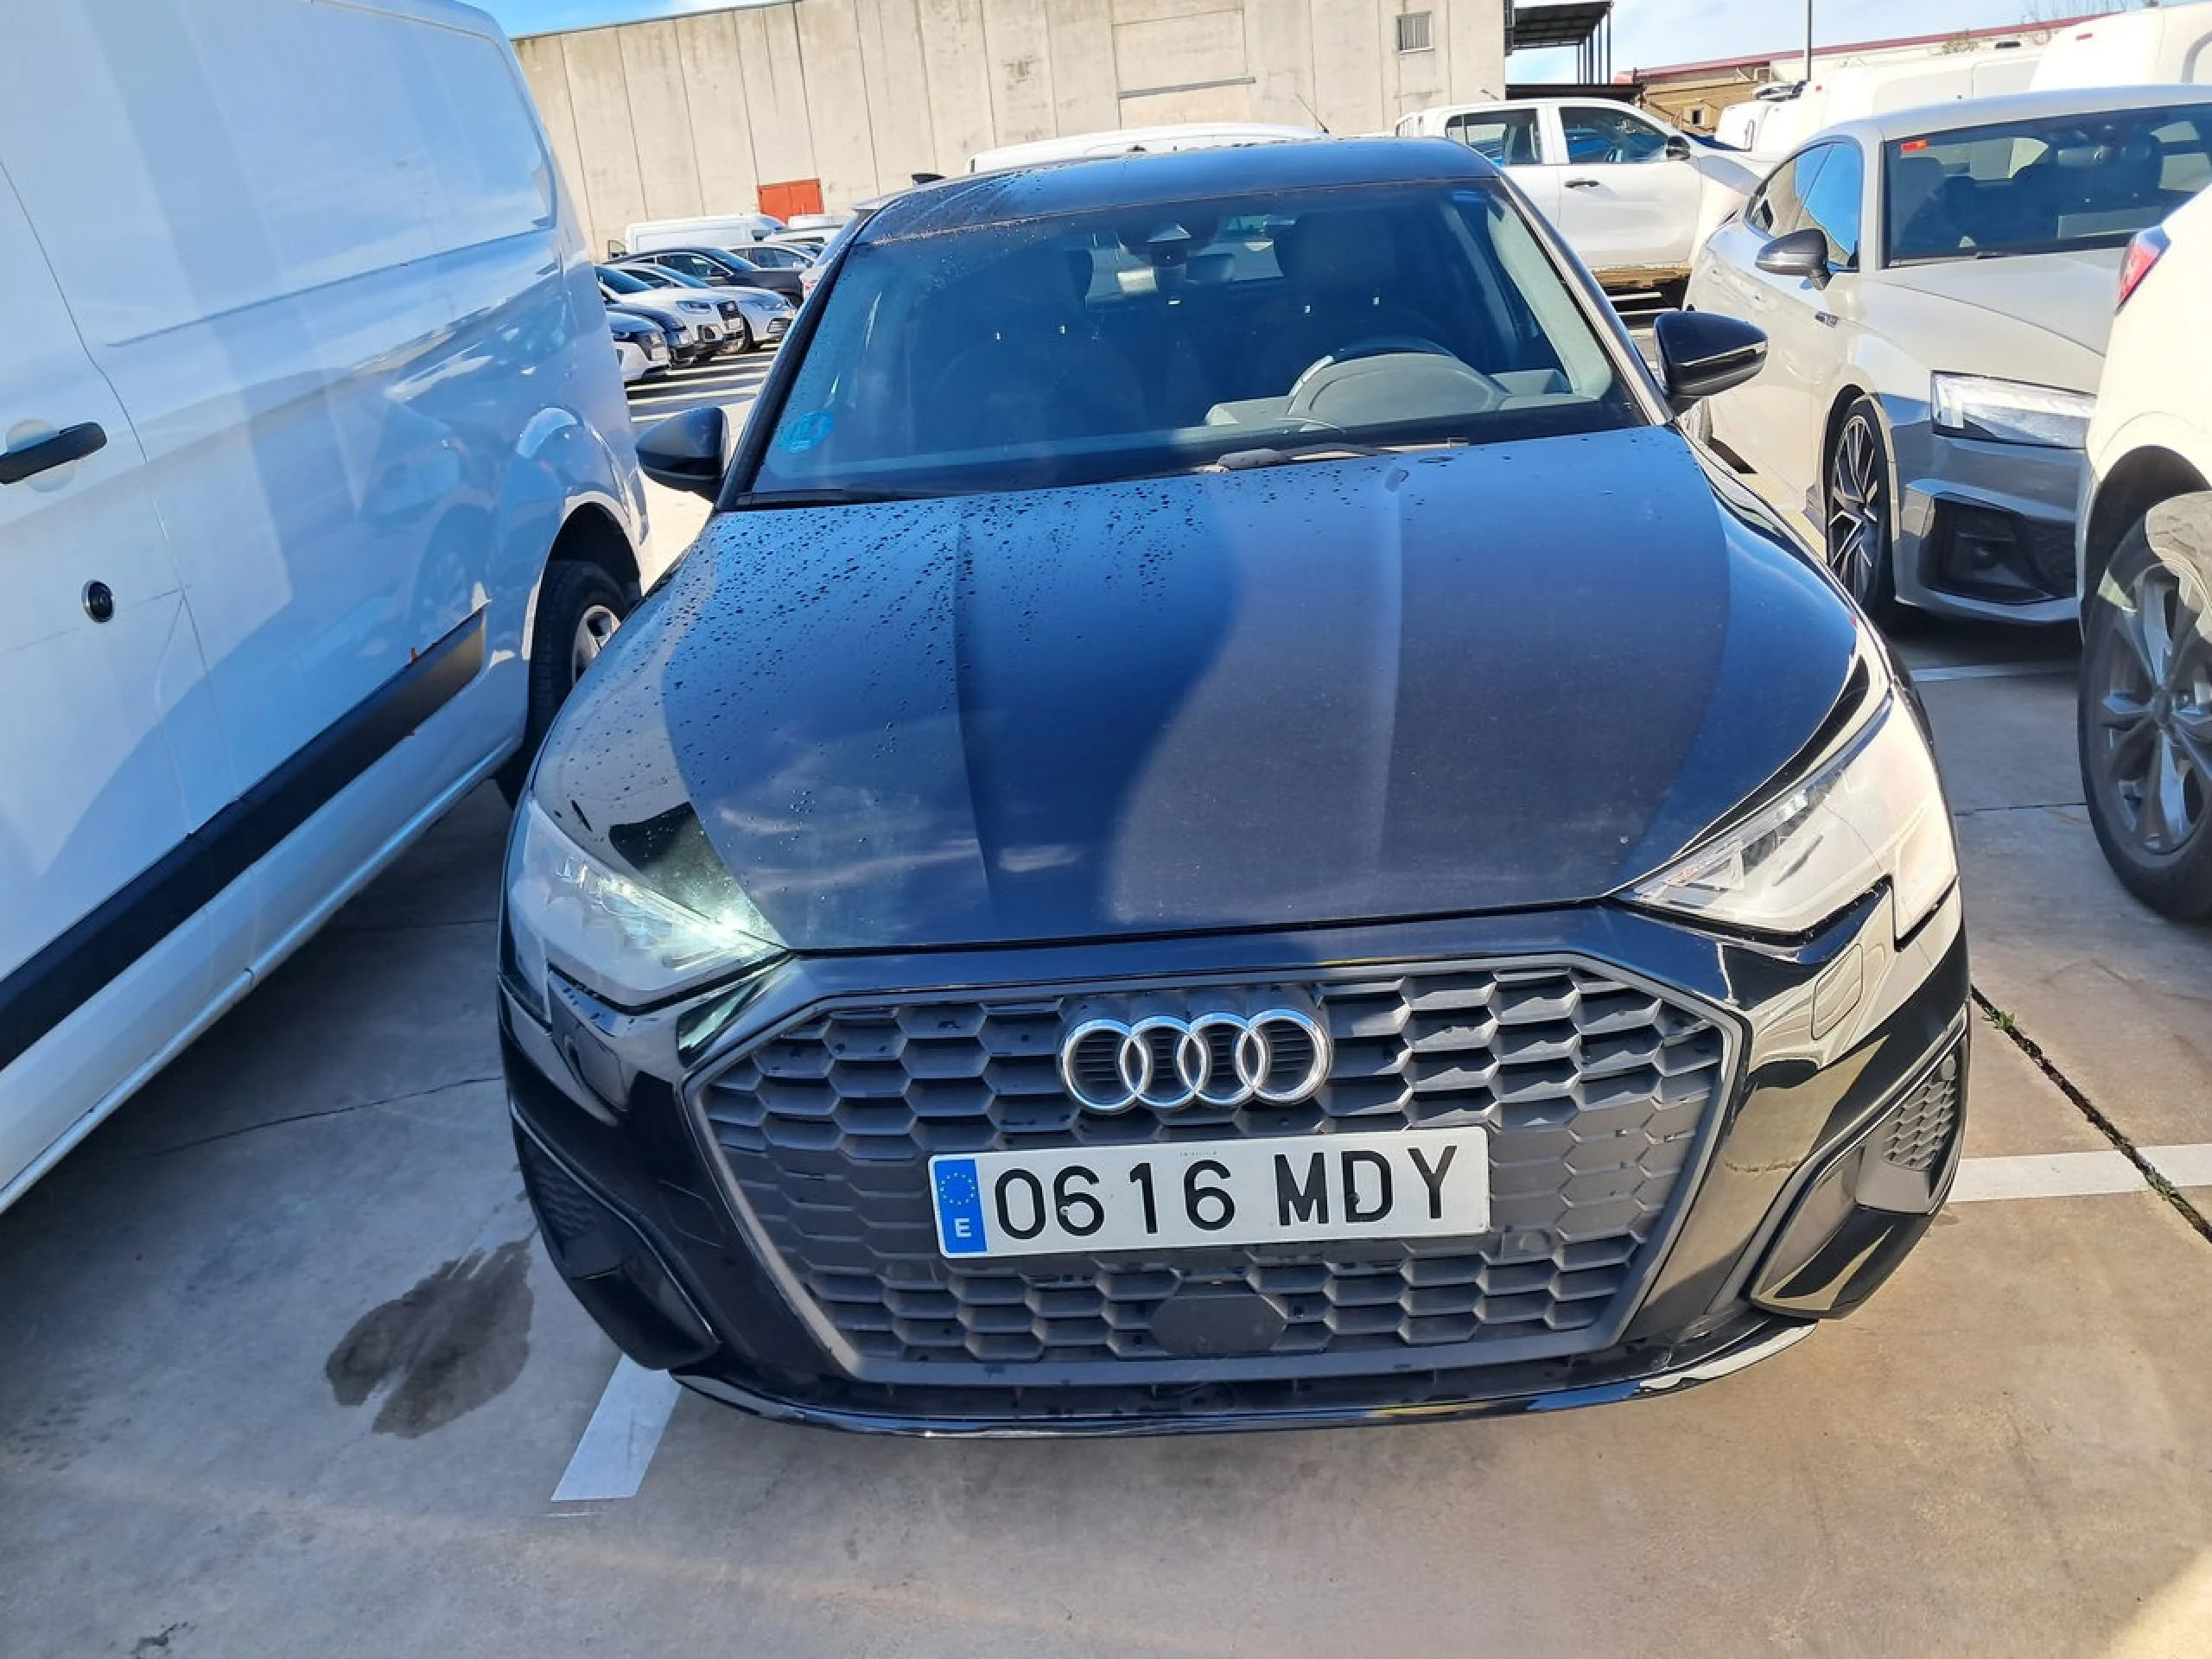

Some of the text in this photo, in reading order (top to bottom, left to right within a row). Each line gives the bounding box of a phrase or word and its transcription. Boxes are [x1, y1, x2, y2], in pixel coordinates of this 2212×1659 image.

[995, 1145, 1458, 1240] 0616 MDY
[953, 1217, 972, 1238] E
